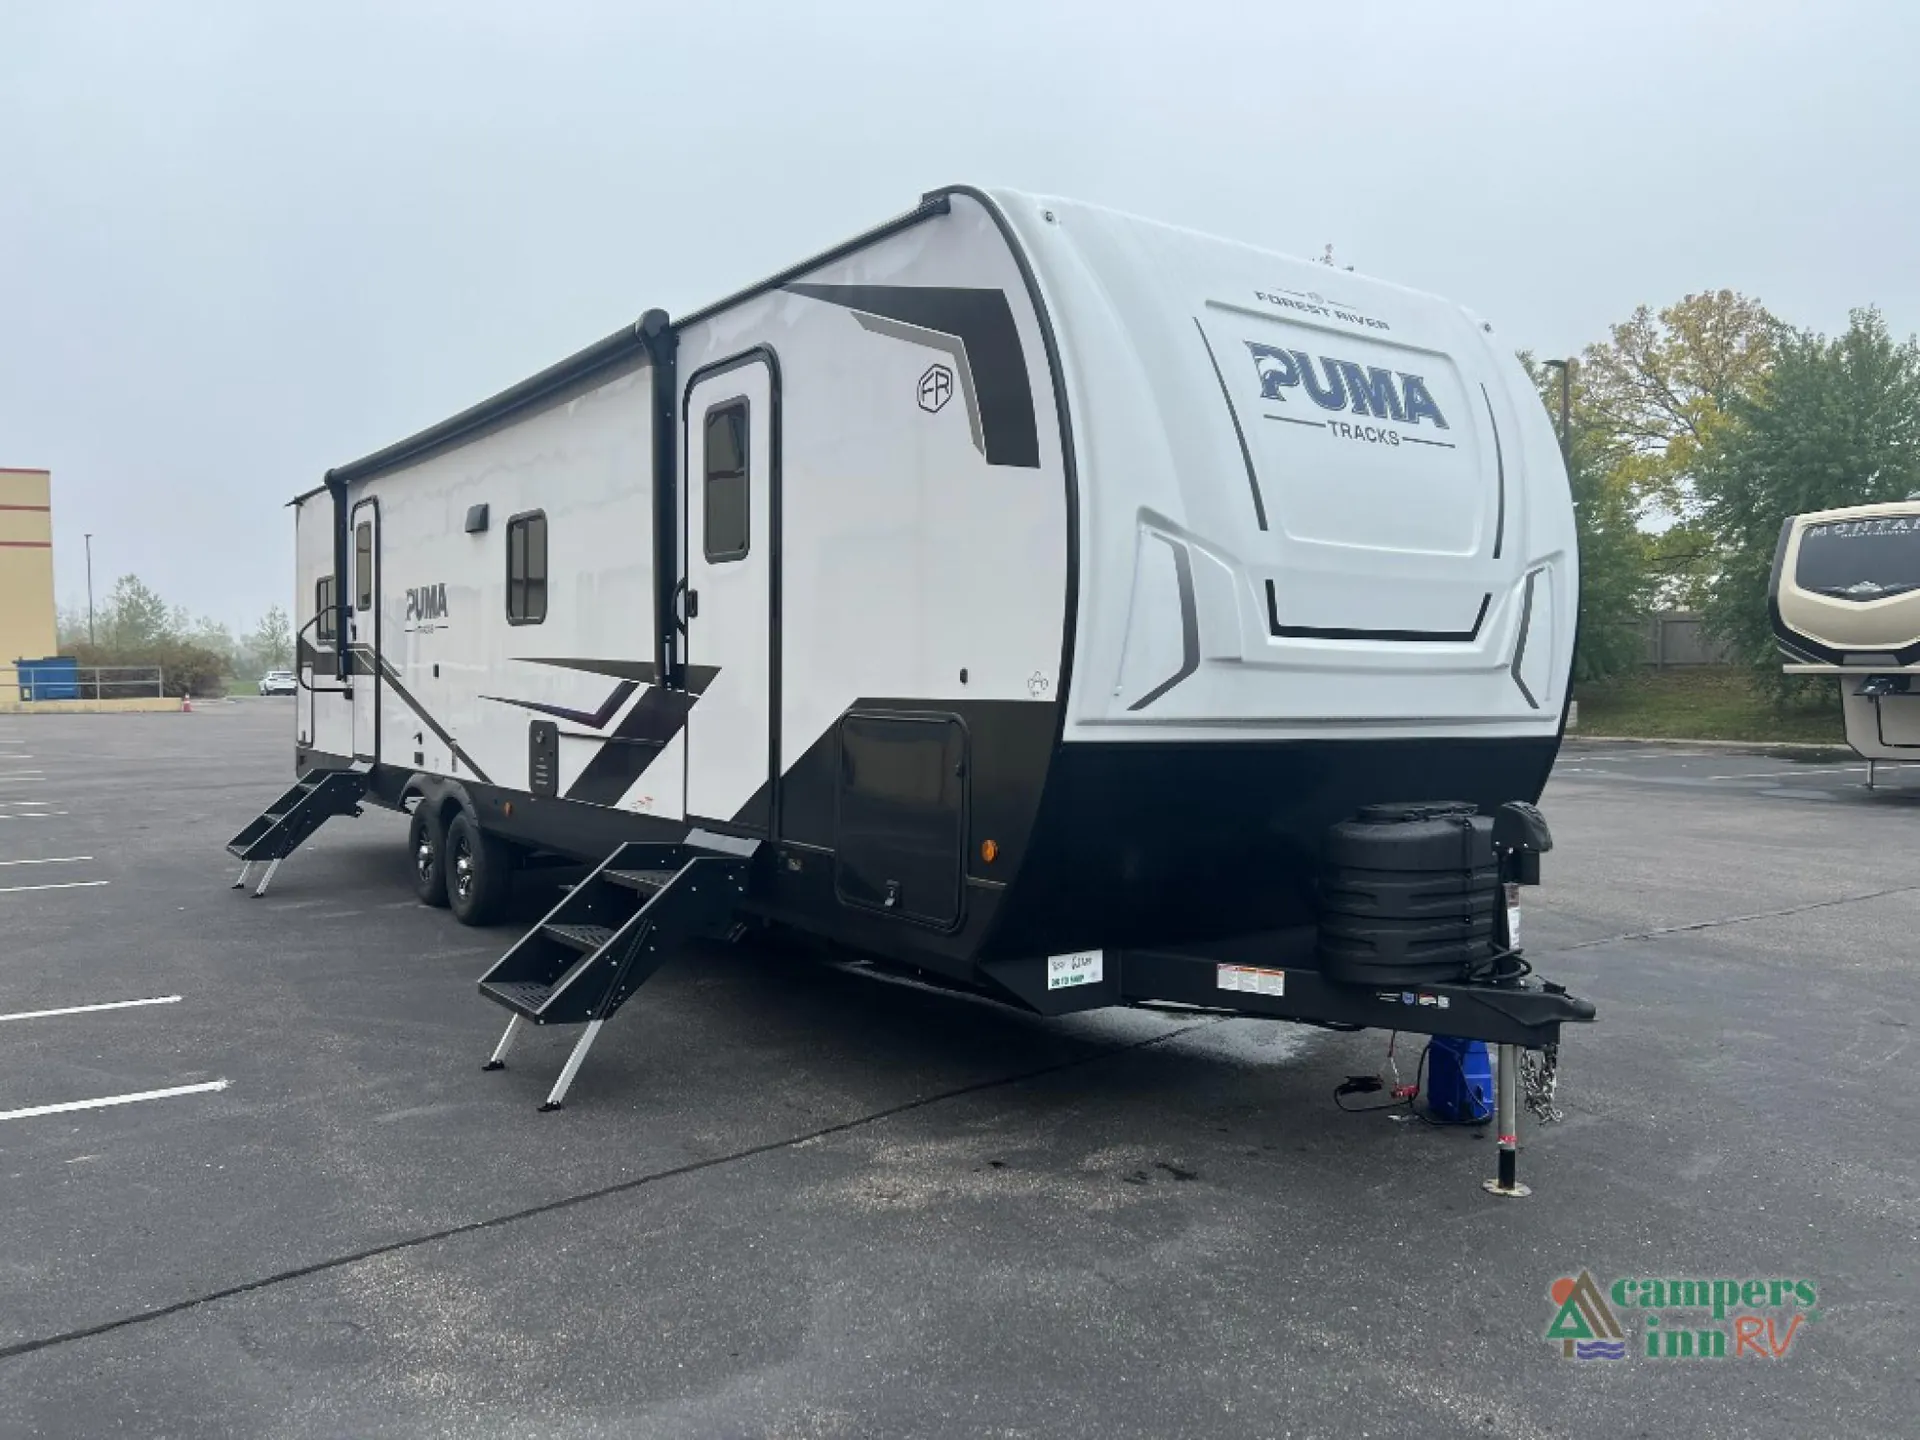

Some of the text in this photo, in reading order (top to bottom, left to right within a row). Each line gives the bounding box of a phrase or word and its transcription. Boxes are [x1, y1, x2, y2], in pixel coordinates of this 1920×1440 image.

[1255, 291, 1390, 330] FOREST RIVER
[1243, 338, 1450, 429] PUMA
[1327, 420, 1400, 445] TRACKS
[405, 582, 448, 621] PUMA
